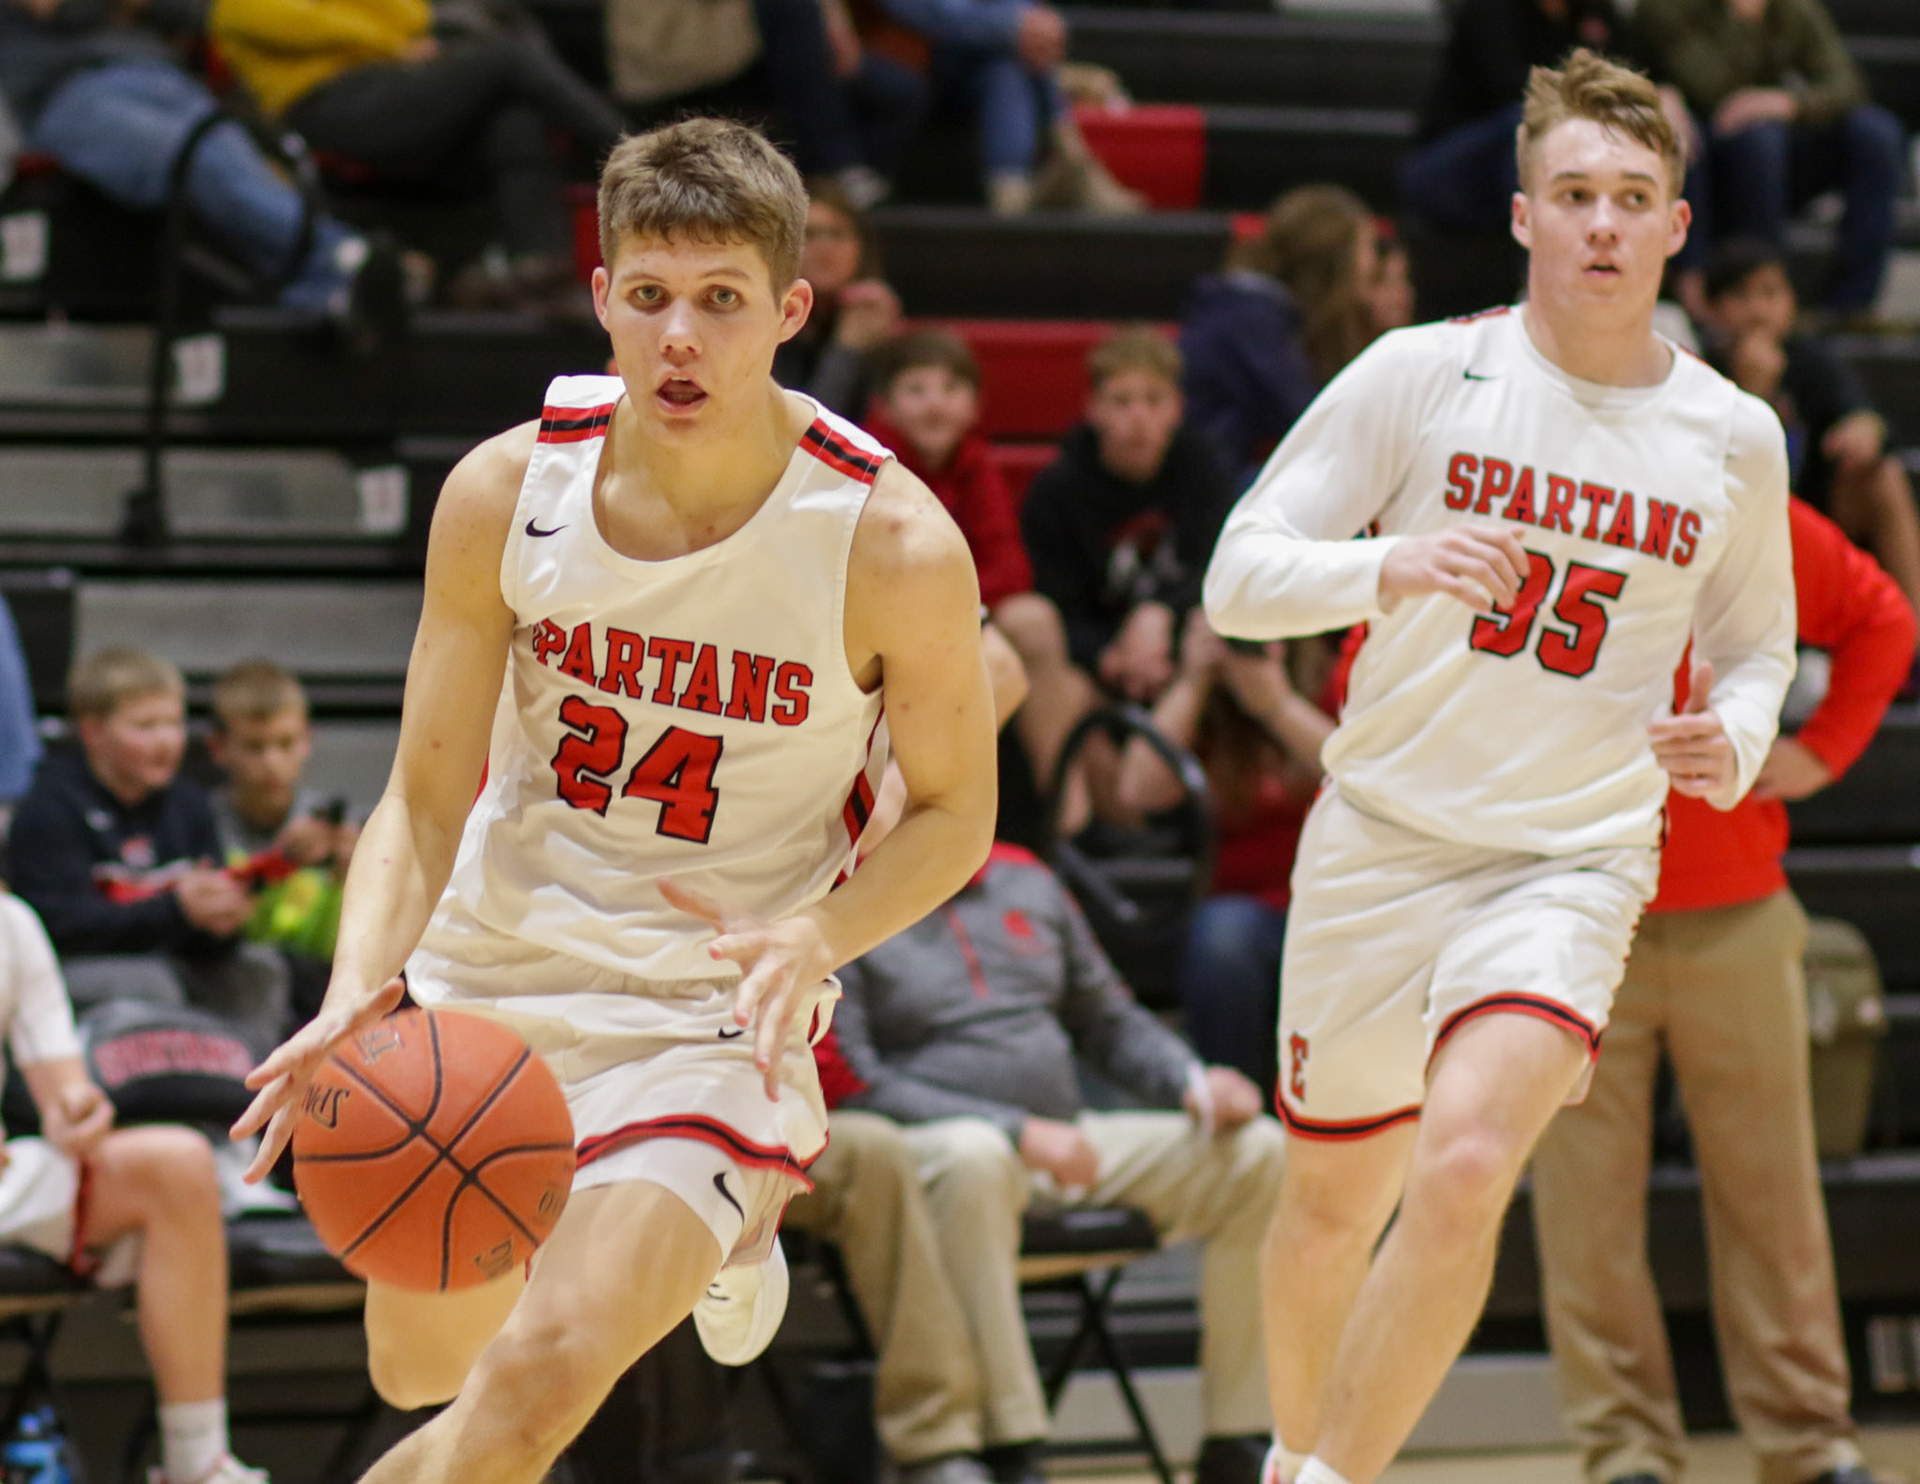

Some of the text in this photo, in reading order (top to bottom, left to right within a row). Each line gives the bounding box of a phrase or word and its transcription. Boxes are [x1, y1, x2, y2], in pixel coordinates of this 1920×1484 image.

[1444, 451, 1702, 567] SPARTANS
[1469, 547, 1629, 680] 35
[550, 694, 723, 844] 24
